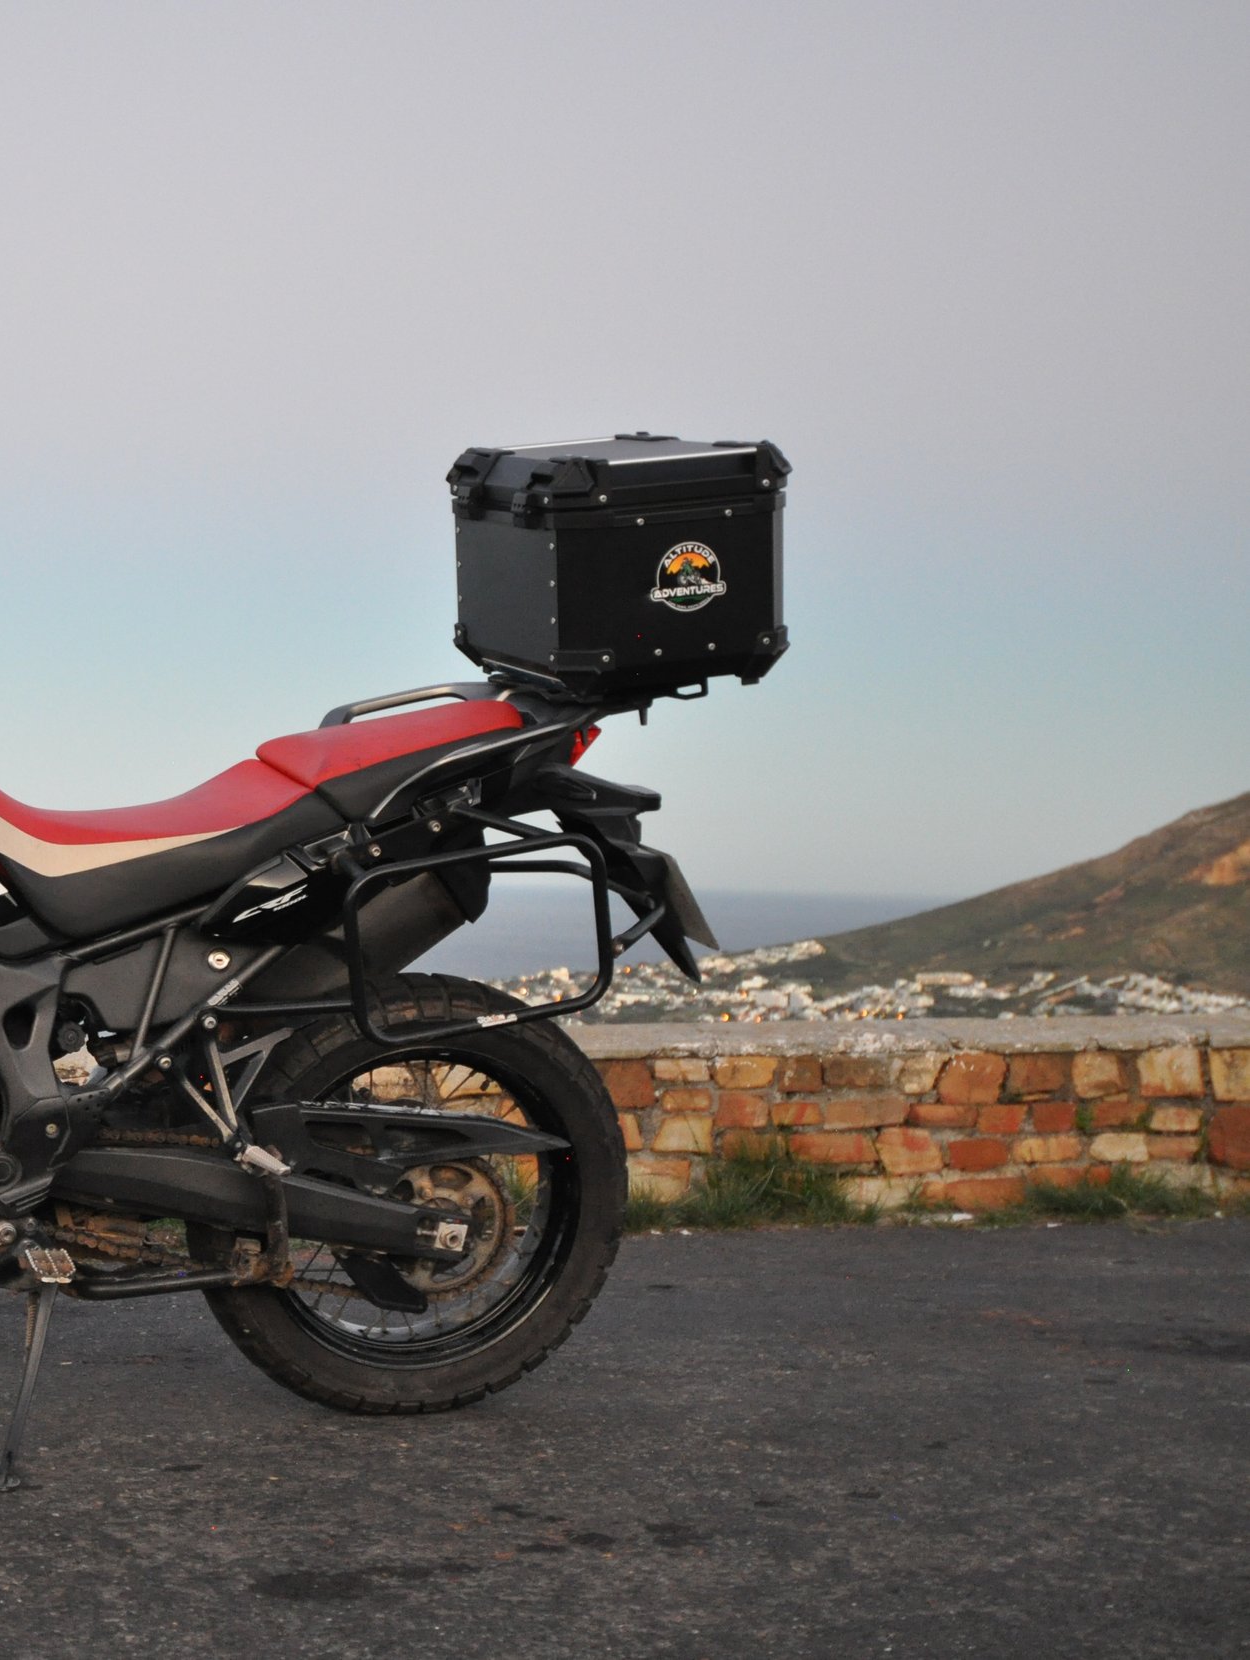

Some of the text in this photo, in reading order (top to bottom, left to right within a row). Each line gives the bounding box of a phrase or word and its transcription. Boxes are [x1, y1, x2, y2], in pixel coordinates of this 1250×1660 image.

[664, 545, 715, 567] ALTITUDE
[654, 584, 724, 598] ADVENTURES
[232, 884, 308, 923] CRF
